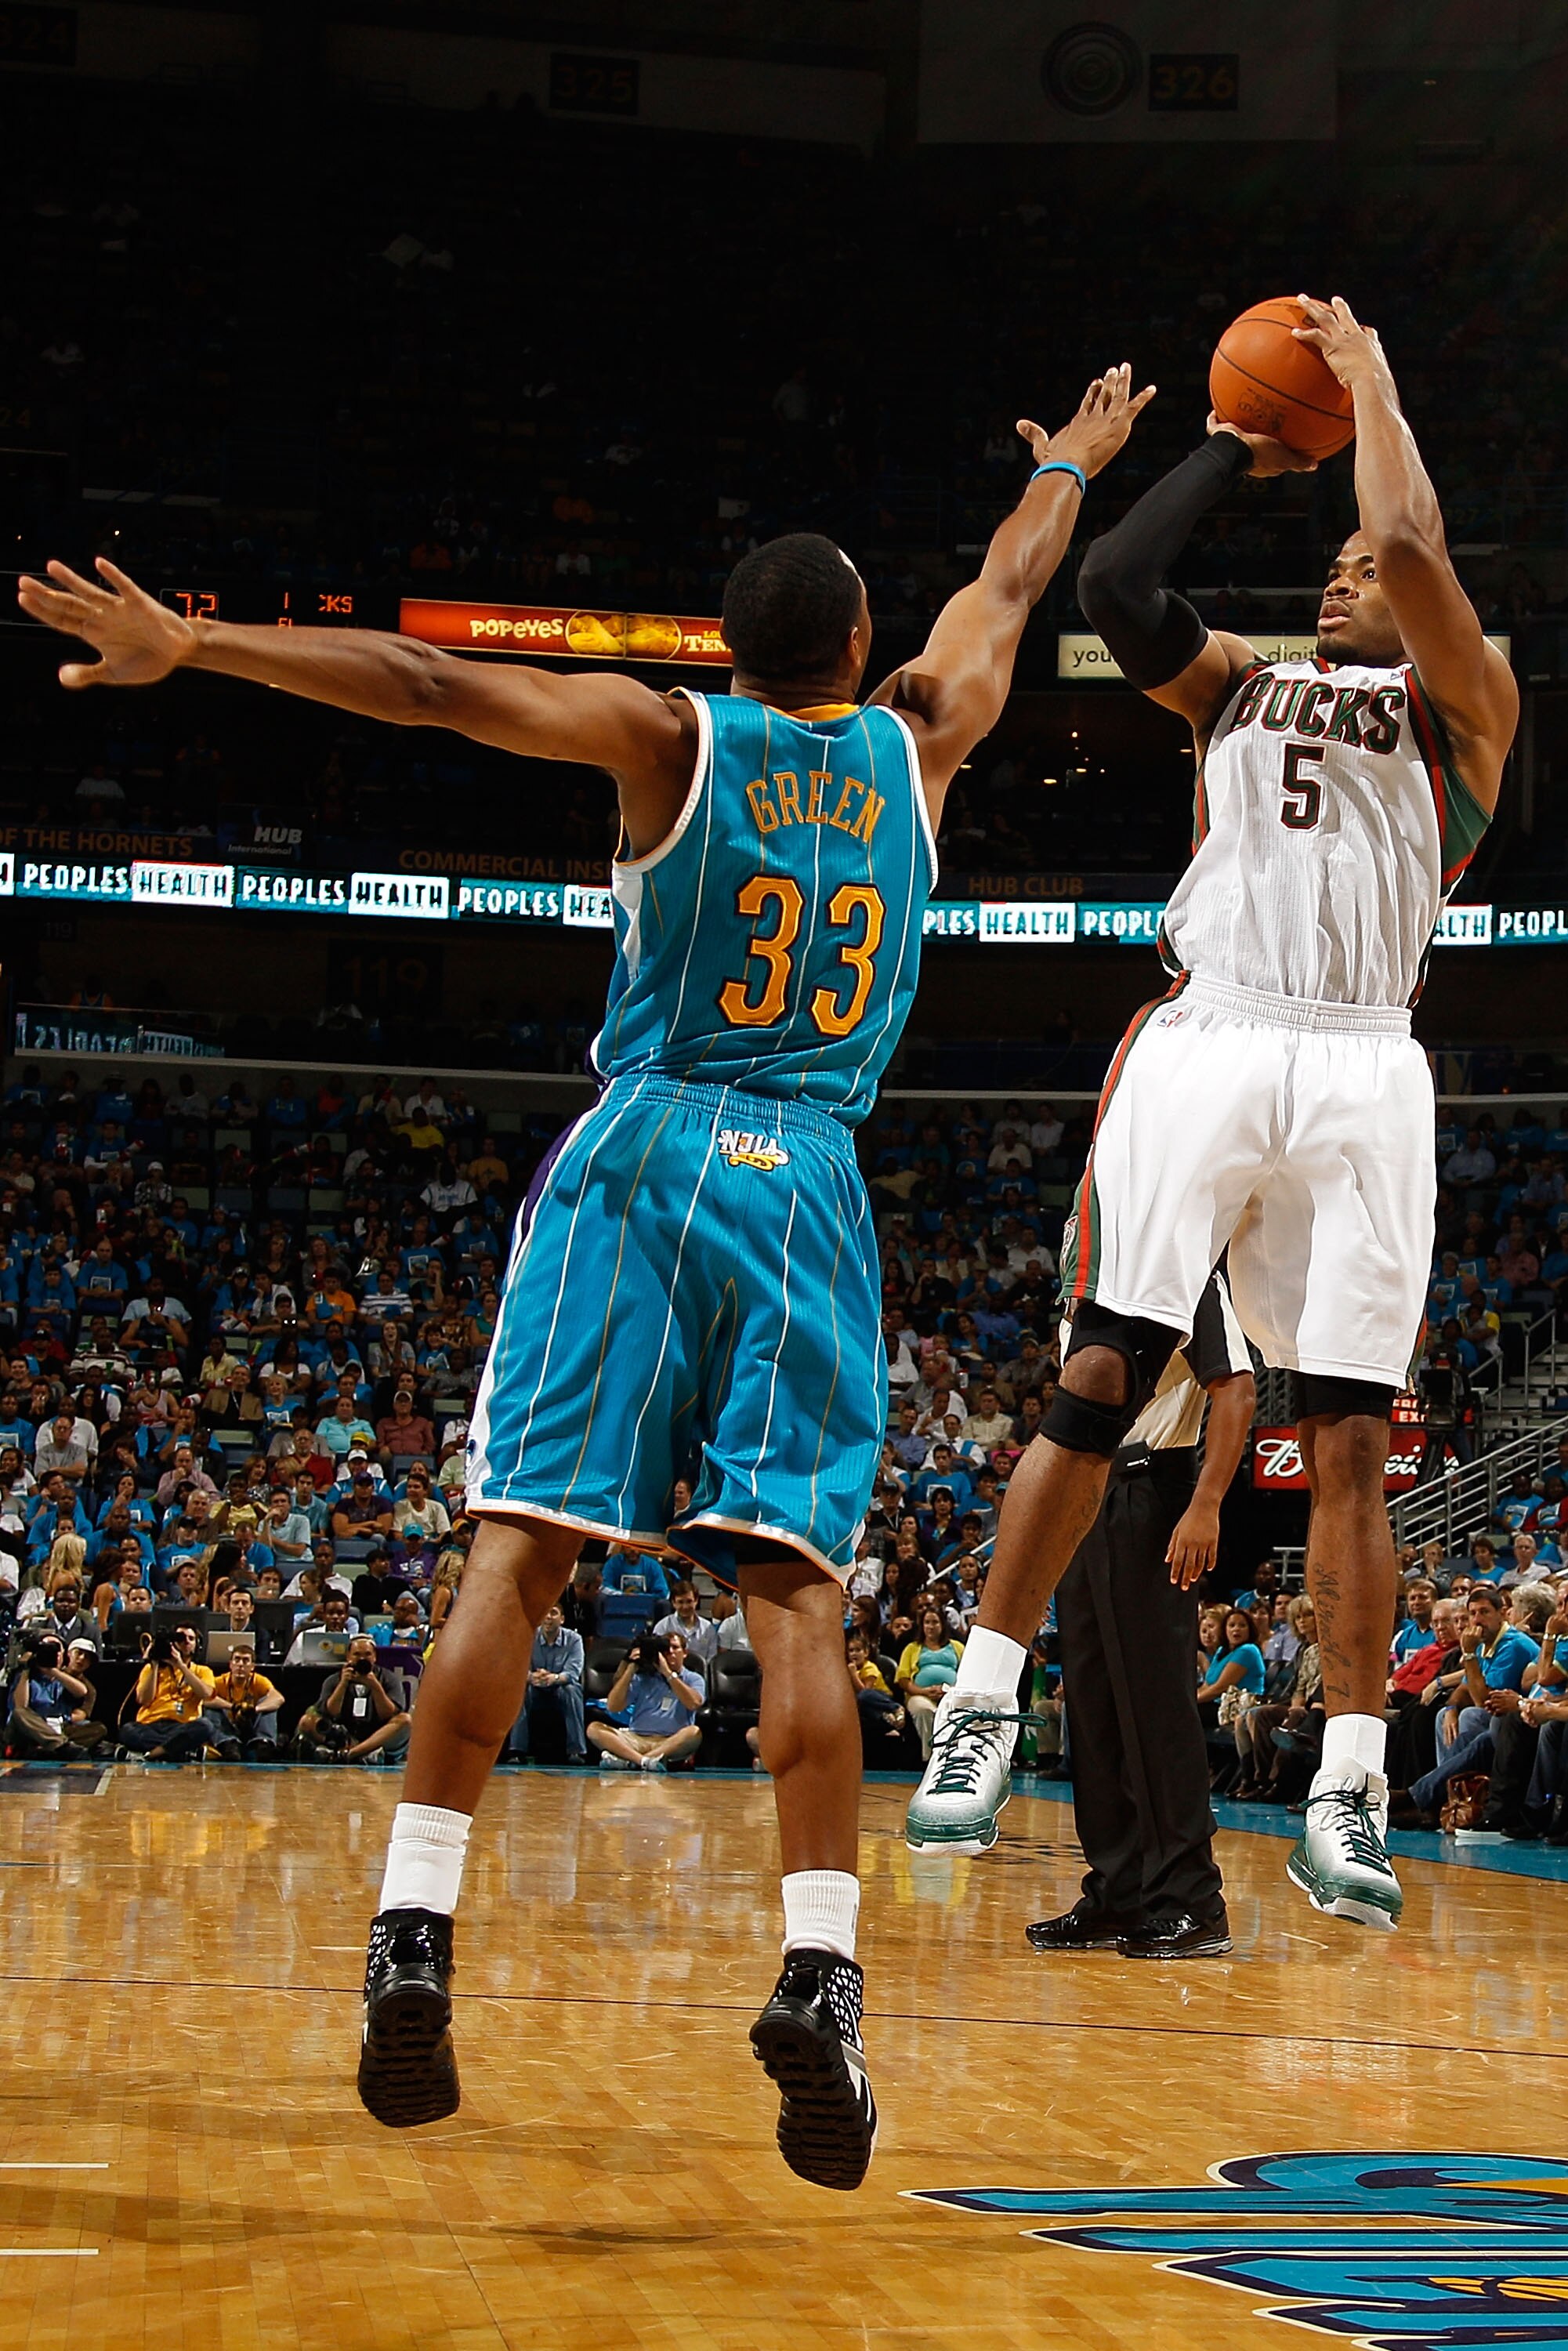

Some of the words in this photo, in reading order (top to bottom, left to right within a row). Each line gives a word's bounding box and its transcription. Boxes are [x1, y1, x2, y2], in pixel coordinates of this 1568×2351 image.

[557, 64, 636, 104] 325
[1153, 63, 1236, 100] 326
[1230, 672, 1407, 755] BUCKS
[1279, 741, 1326, 831] 5
[745, 770, 886, 844] GREEN
[23, 828, 71, 851] THE
[77, 831, 194, 857] HORNETS
[227, 844, 292, 856] International
[253, 826, 302, 844] HUB
[397, 848, 559, 878] COMMERCIAL
[566, 859, 611, 881] INS
[23, 863, 129, 894] PEOPLES
[140, 871, 227, 900] HEALTH
[241, 875, 346, 907] PEOPLES
[355, 882, 442, 911] HEALTH
[458, 886, 559, 918] PEOPLES
[968, 875, 1018, 895] HUB
[1023, 877, 1085, 896] CLUB
[986, 912, 1068, 935] HEALTH
[716, 871, 887, 1038] 33
